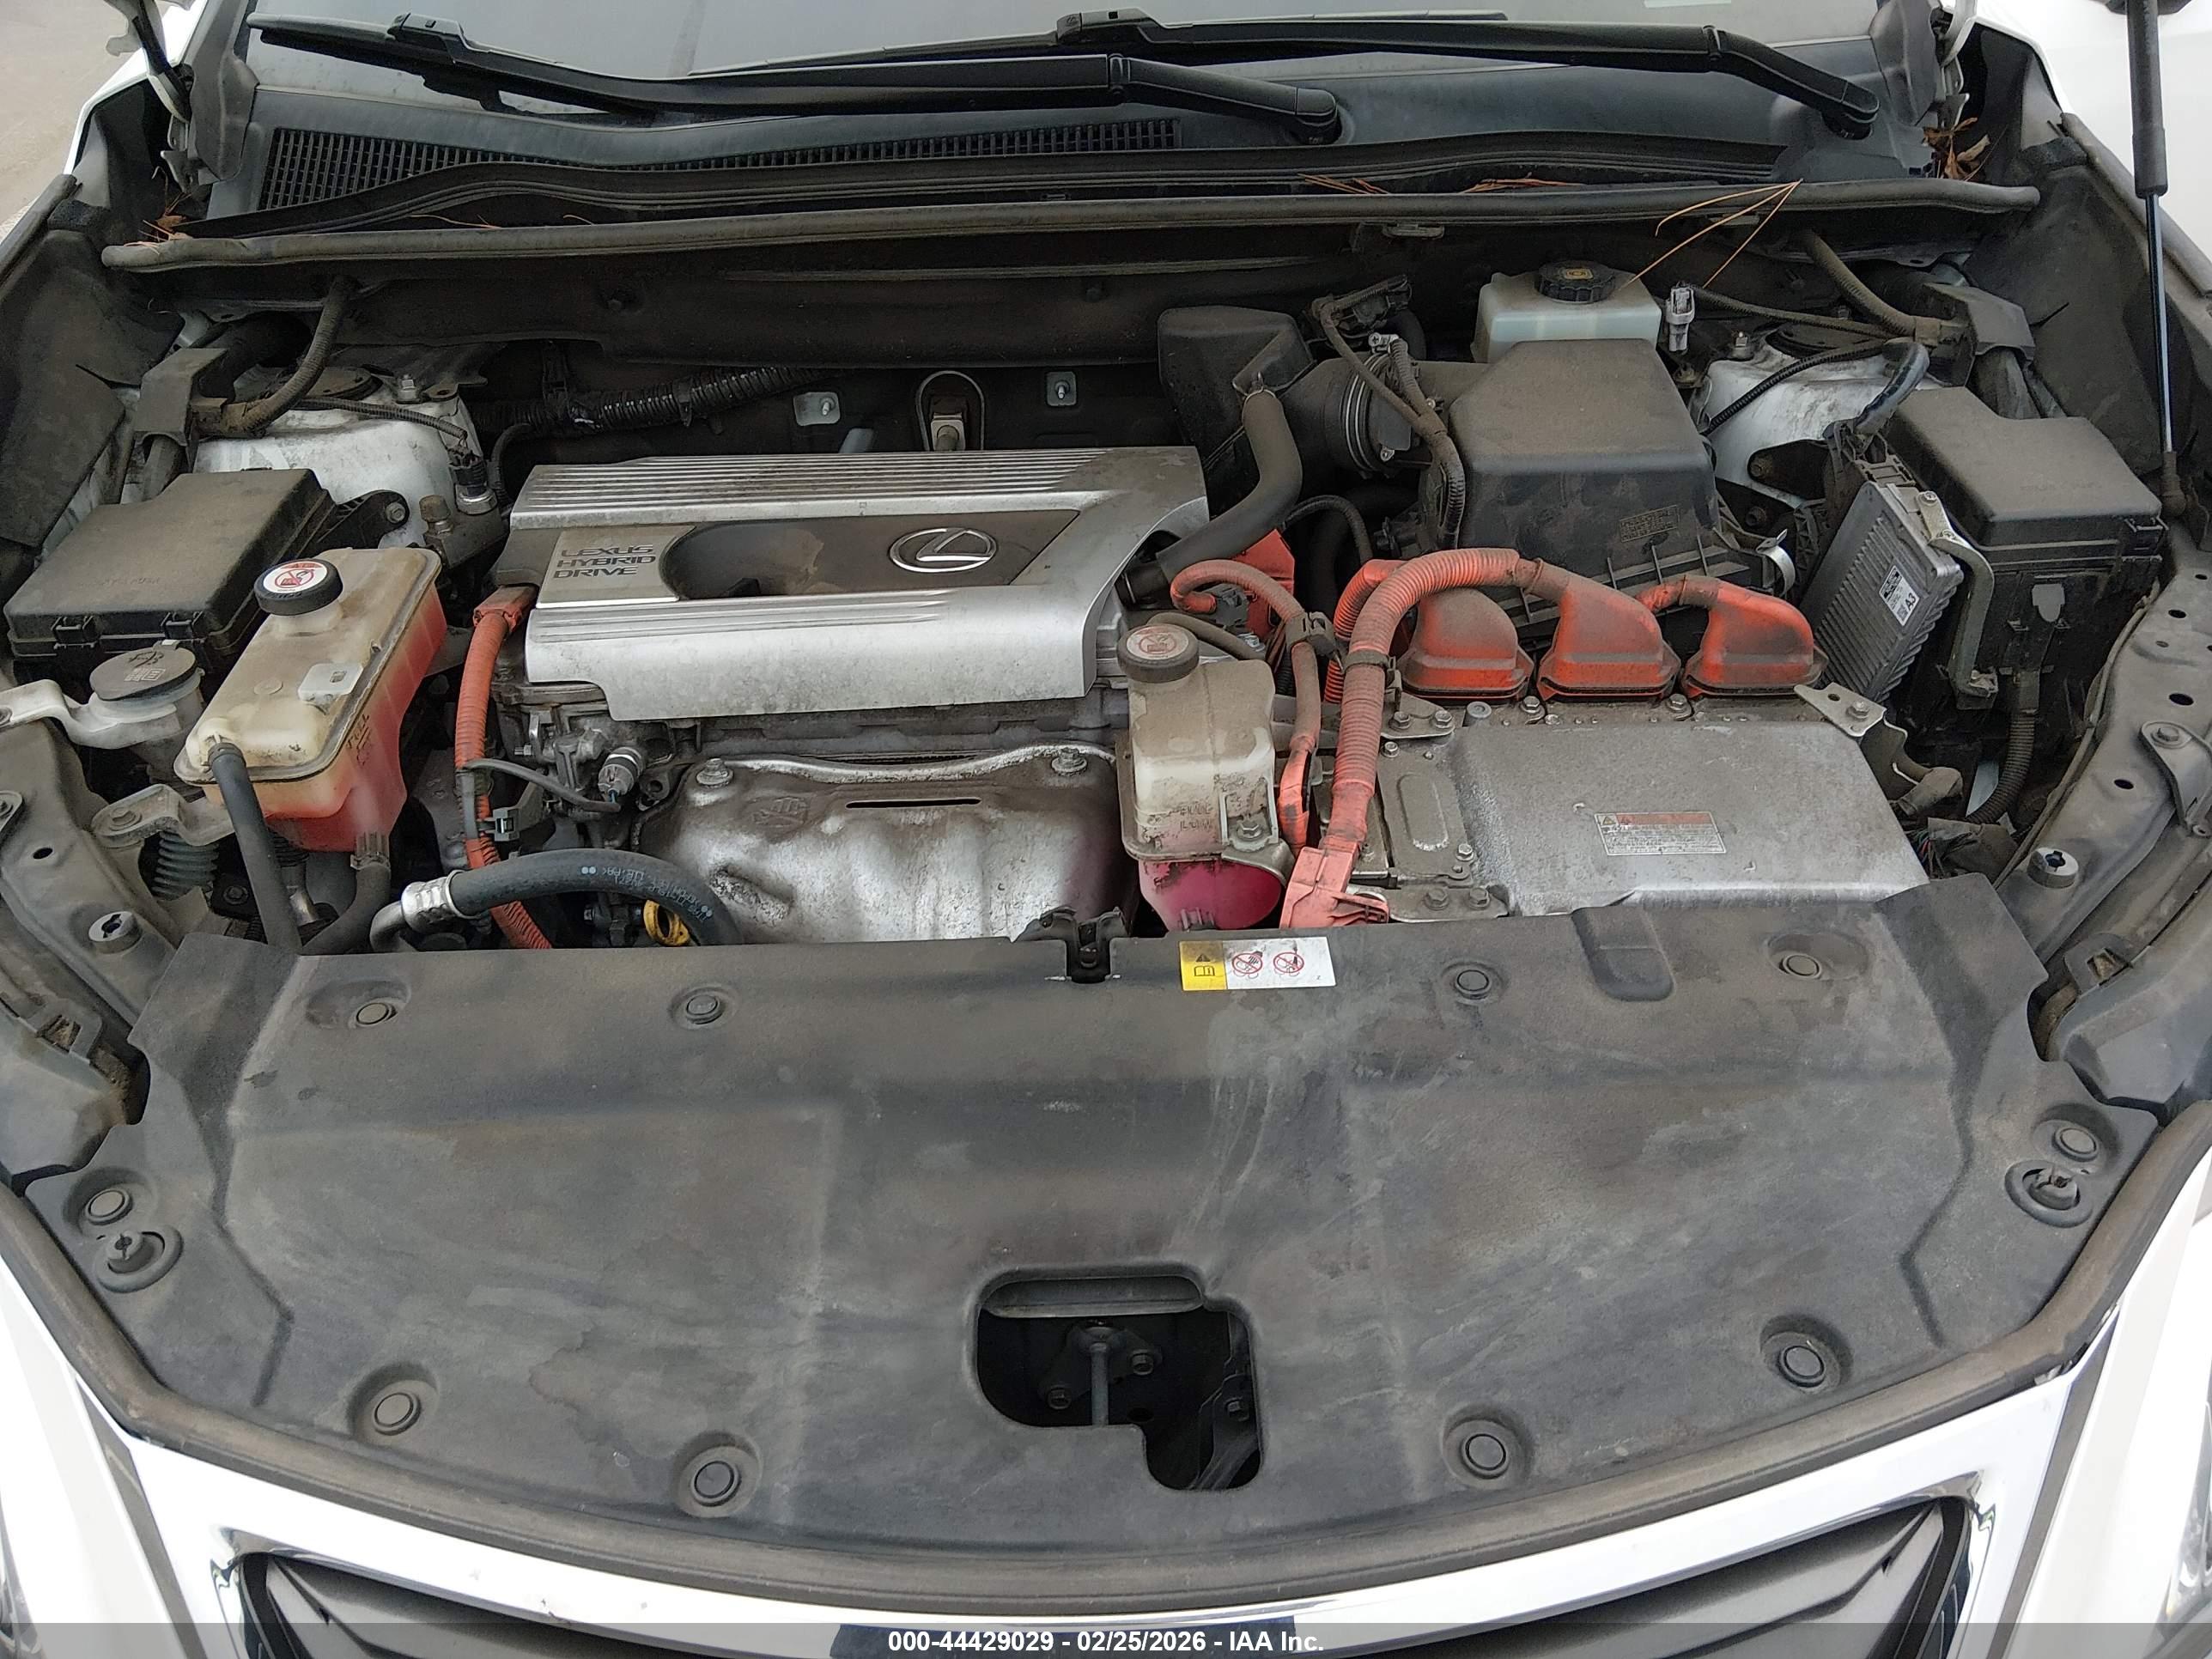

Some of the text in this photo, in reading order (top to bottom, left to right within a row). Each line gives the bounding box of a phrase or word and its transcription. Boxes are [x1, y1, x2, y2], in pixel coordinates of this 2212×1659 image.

[561, 544, 653, 557] LEXUS
[556, 555, 656, 568] HYBRID
[553, 567, 639, 579] DRIVE
